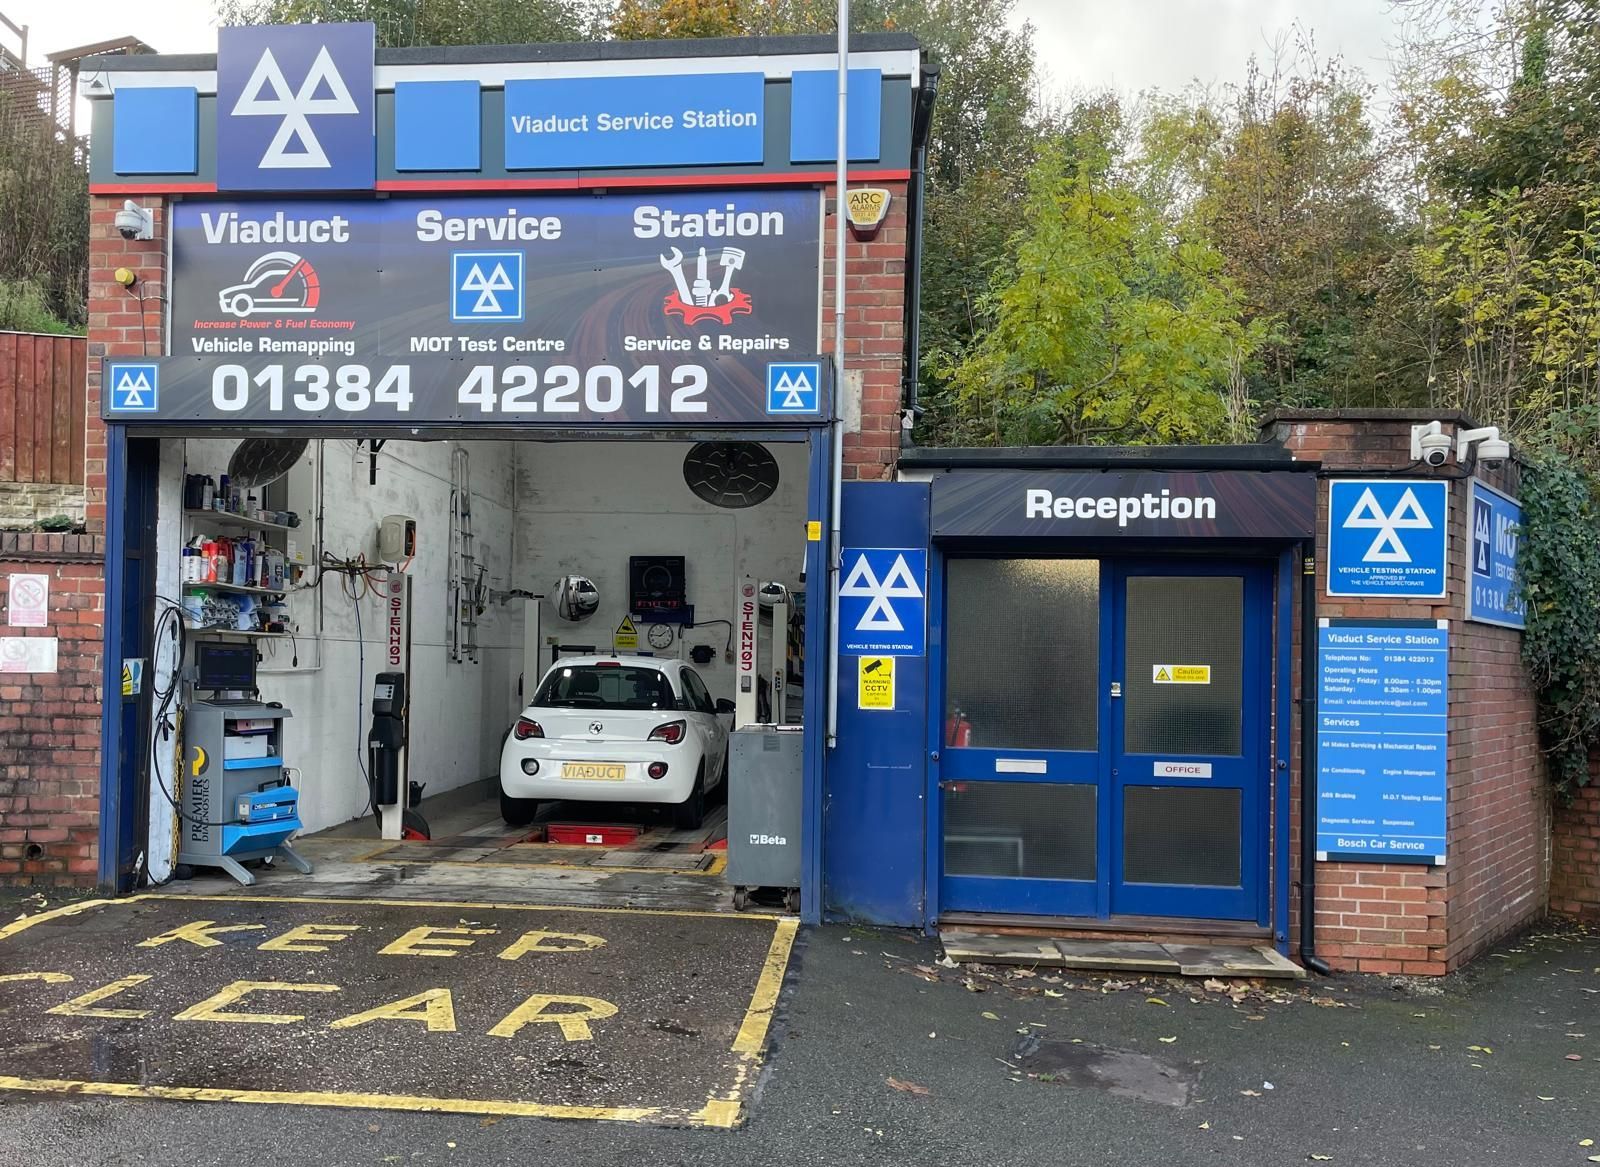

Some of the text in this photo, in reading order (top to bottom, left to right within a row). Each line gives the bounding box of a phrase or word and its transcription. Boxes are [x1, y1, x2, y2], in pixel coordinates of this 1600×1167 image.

[511, 109, 757, 134] Viaduct Service Station
[850, 193, 882, 204] ARC
[201, 203, 784, 244] Viaduct Service Station
[194, 320, 356, 330] Increase Power & Fuel Economy
[191, 337, 355, 356] Vehicle Remapping
[410, 336, 565, 352] MOT Test Centre
[624, 335, 790, 353] Service & Repairs
[211, 364, 708, 413] 01384 422012
[1026, 488, 1217, 527] Reception
[1495, 562, 1506, 579] TEST
[1475, 585, 1505, 612] 01384
[1328, 634, 1439, 644] Viaduct Service Station
[1357, 677, 1380, 685] Friday:
[1416, 687, 1441, 695] 1.00pm
[1323, 718, 1360, 726] Services
[563, 766, 624, 778] VIADUCT
[1165, 765, 1201, 774] OFFICE
[760, 834, 787, 845] Beta
[1337, 839, 1425, 850] Bosch Car Service
[134, 920, 607, 960] KEEP
